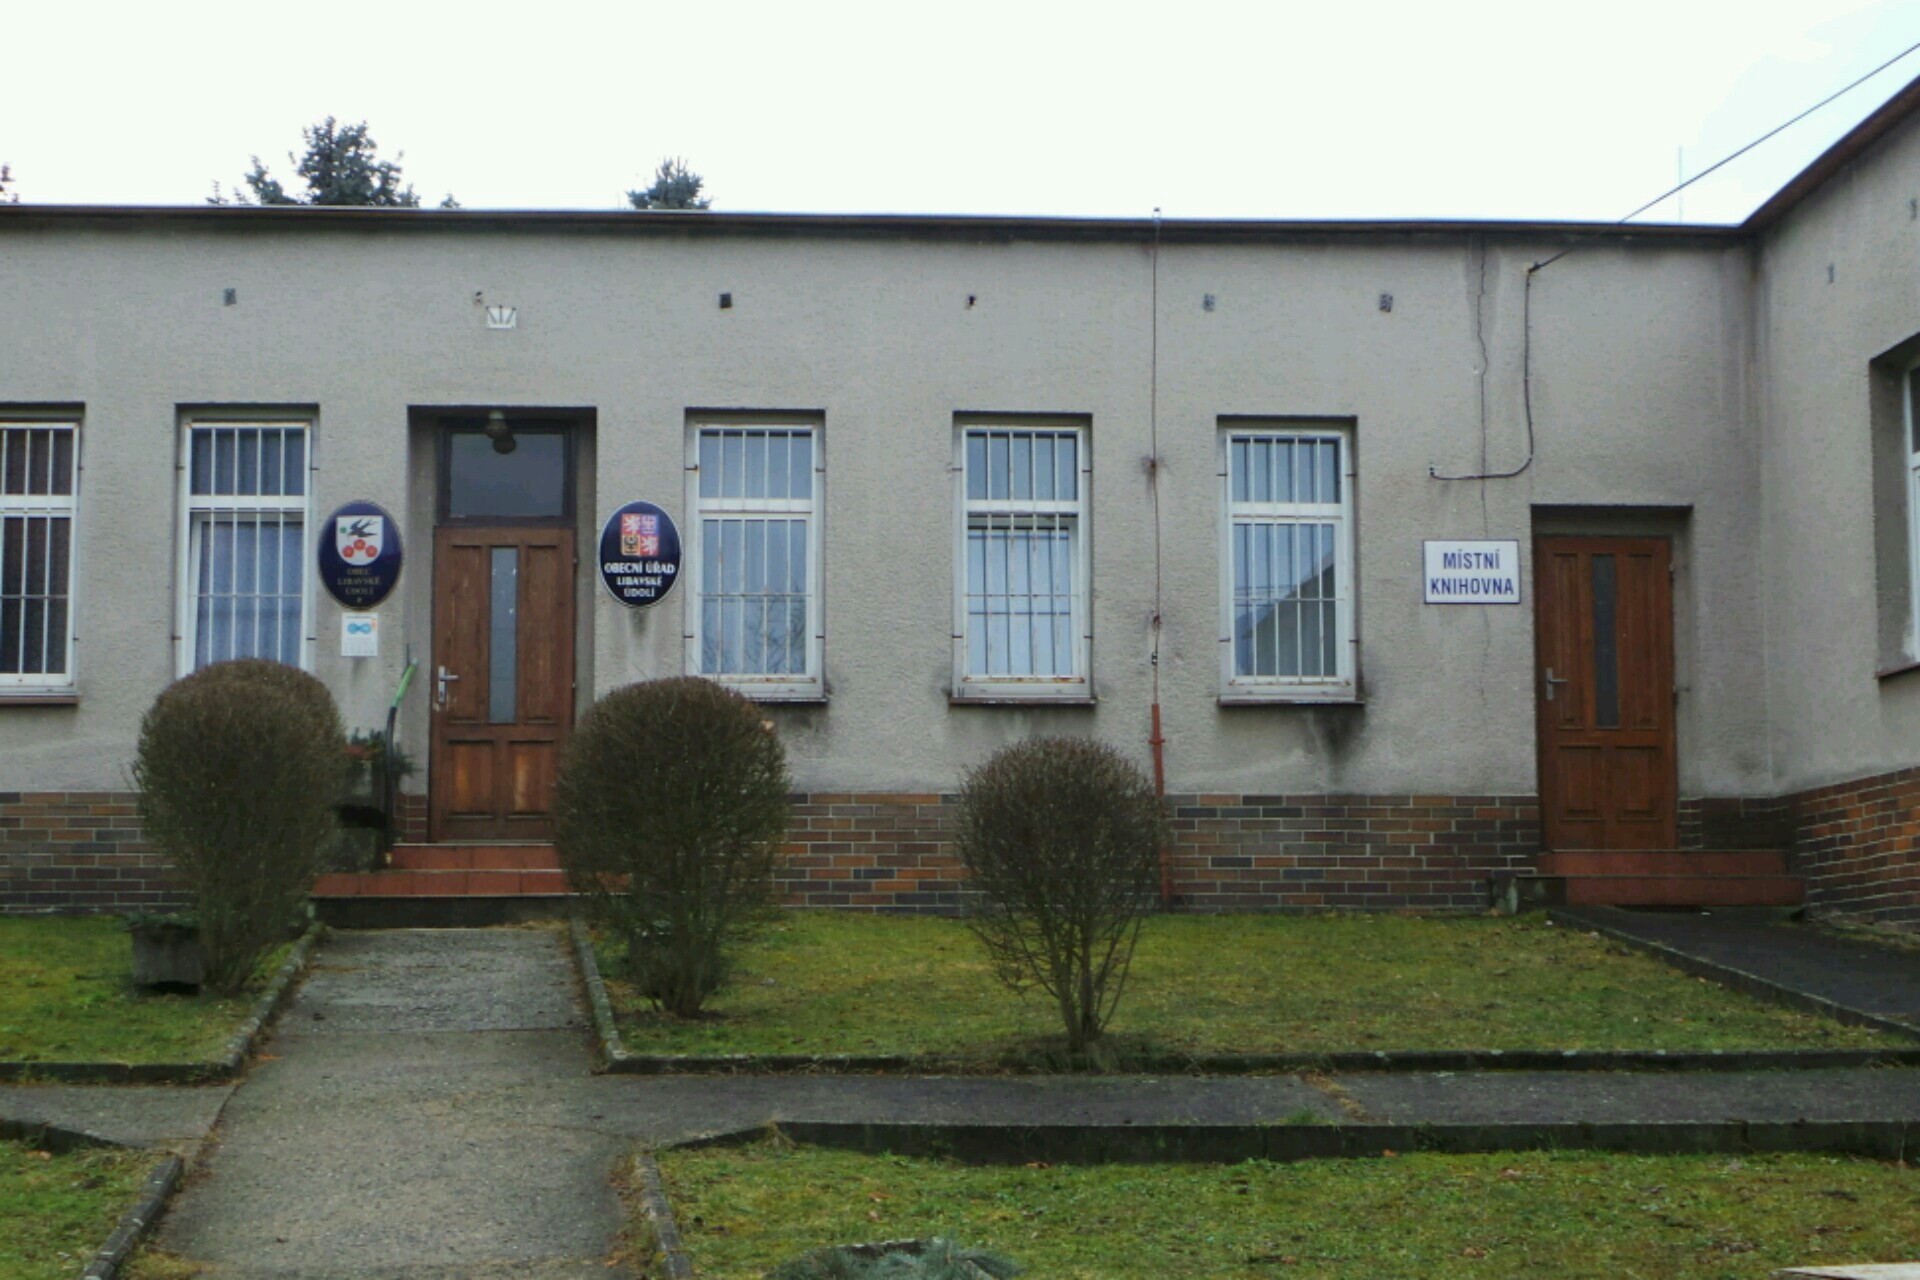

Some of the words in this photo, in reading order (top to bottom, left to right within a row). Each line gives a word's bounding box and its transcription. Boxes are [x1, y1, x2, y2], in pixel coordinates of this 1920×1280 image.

[604, 561, 642, 574] OBECNÍ
[645, 560, 675, 574] ÚŘAD
[1443, 548, 1500, 569] MÍSTNÍ
[1430, 578, 1514, 595] KNIHOVNA
